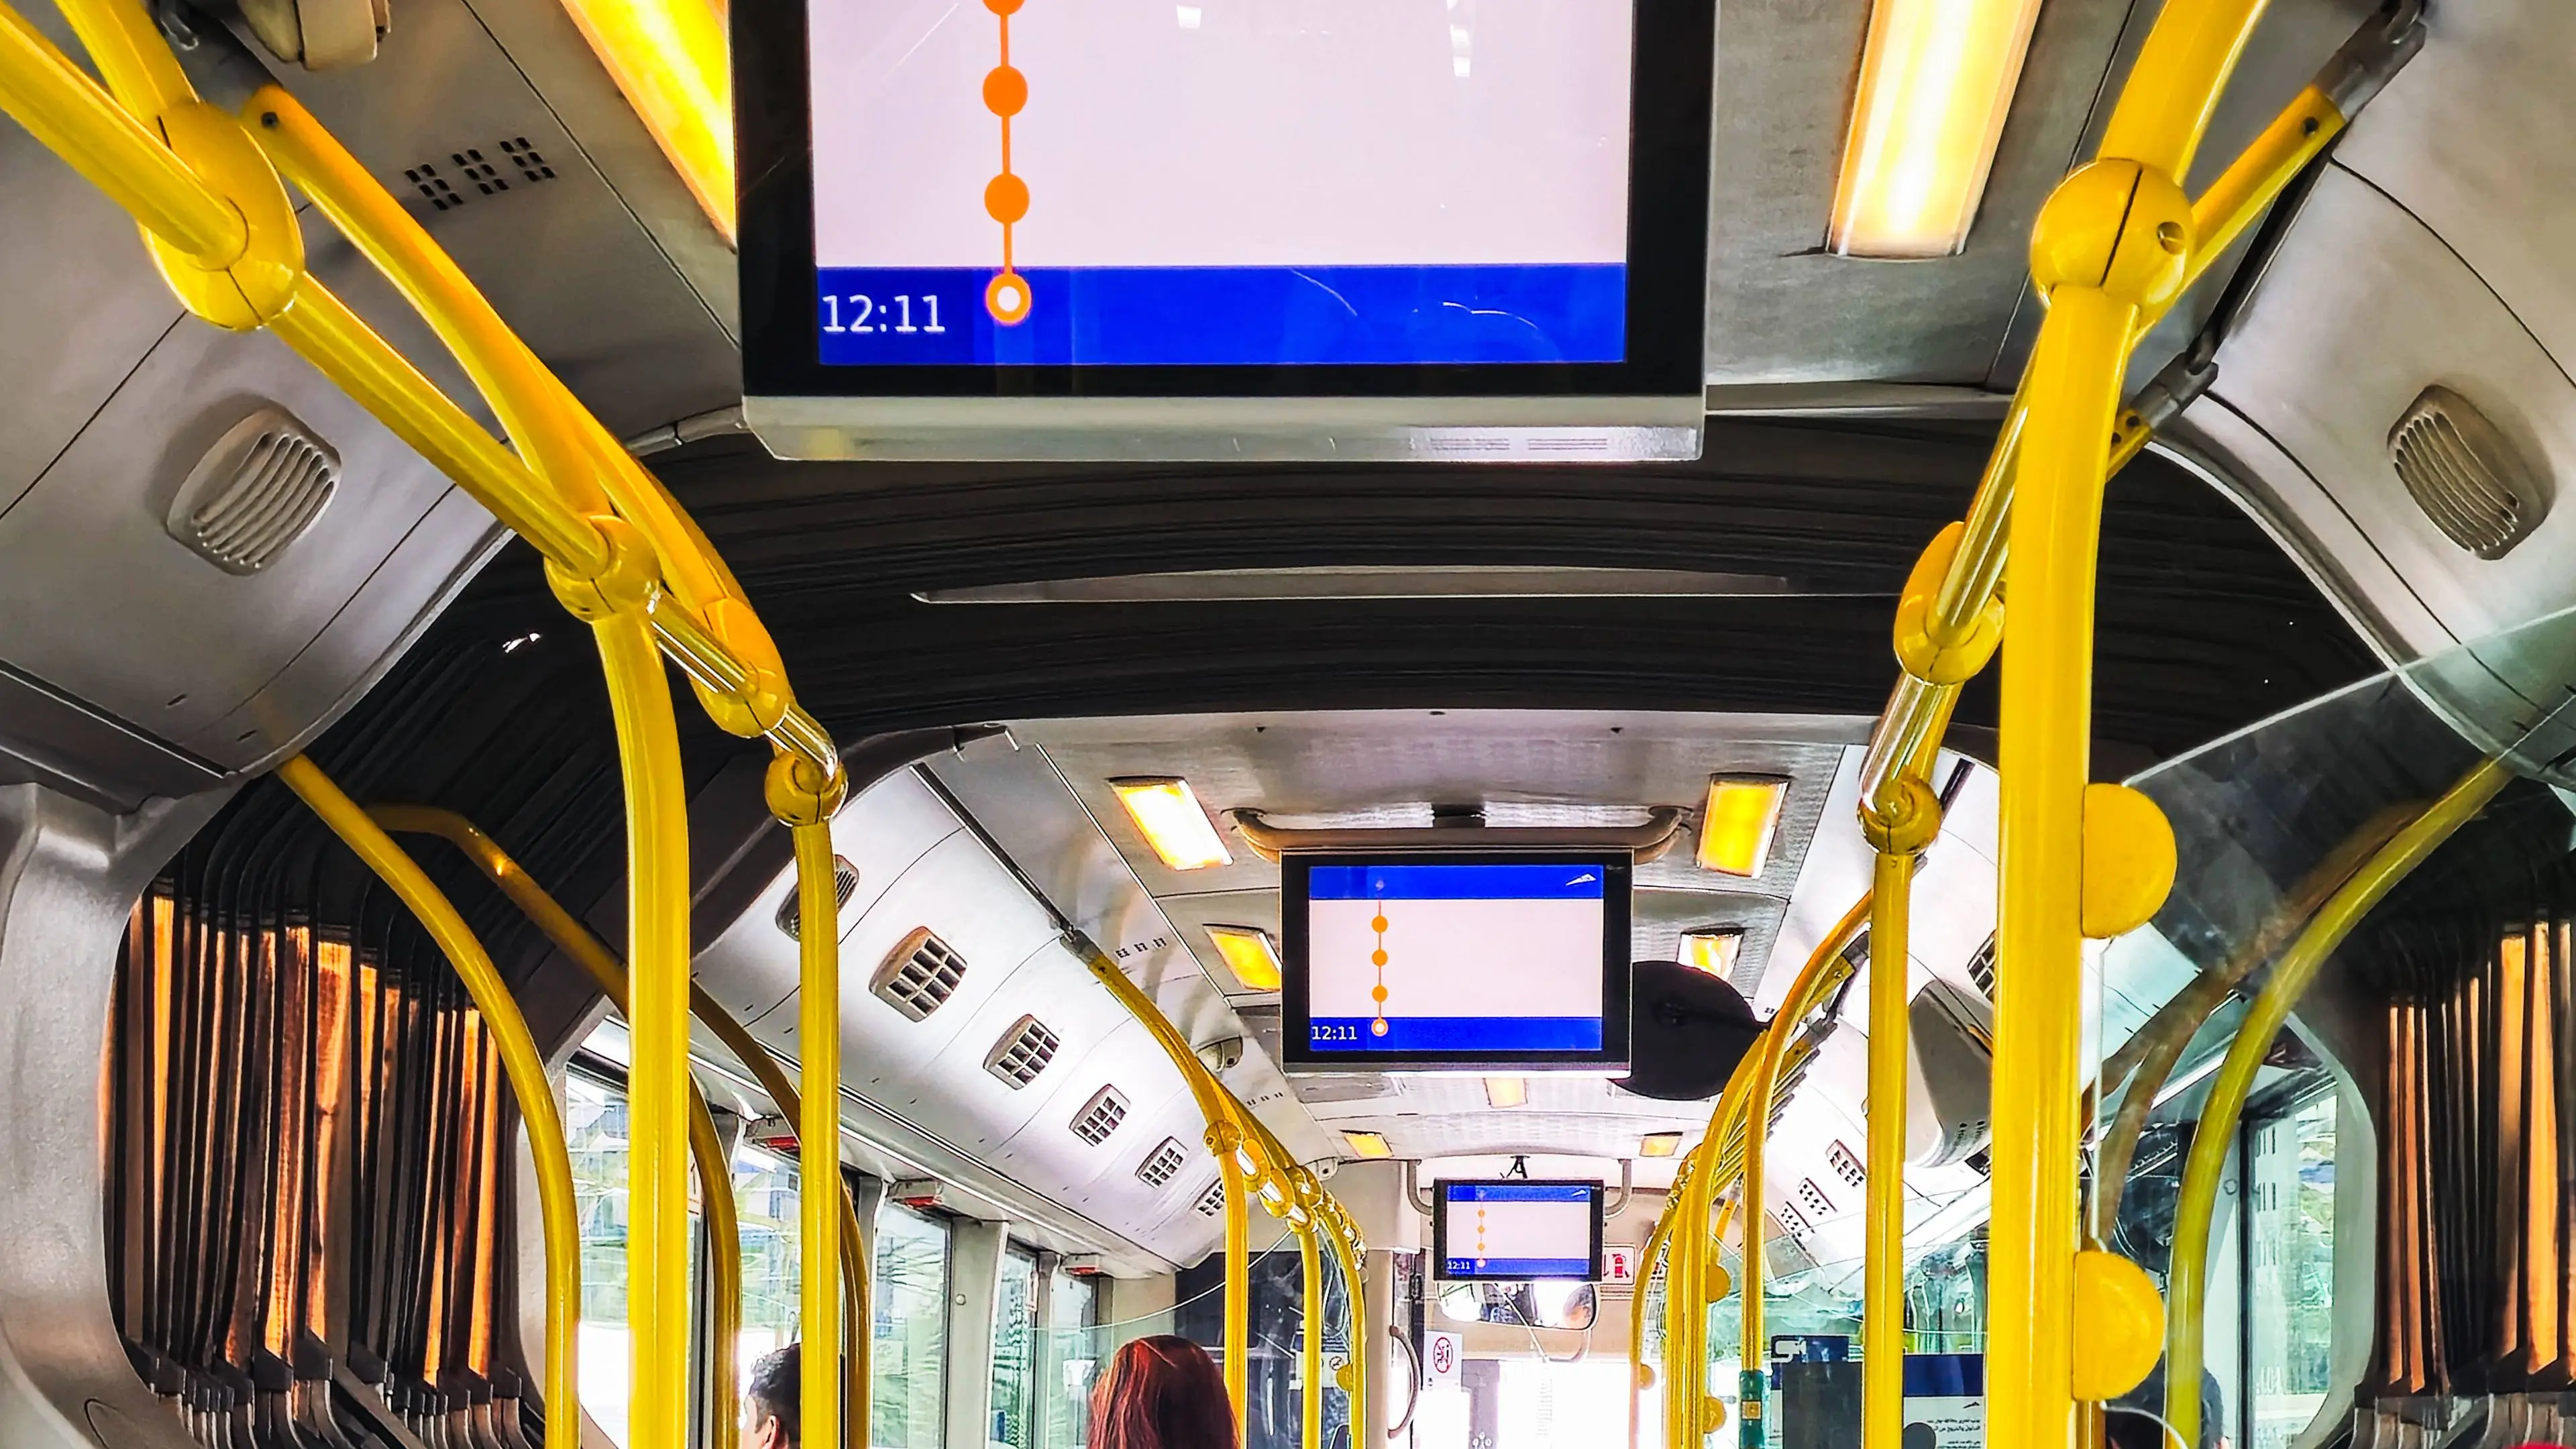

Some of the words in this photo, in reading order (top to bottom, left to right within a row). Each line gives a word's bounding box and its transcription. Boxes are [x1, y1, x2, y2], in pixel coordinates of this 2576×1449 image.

[822, 294, 946, 332] 12:11
[1311, 1026, 1358, 1040] 12:11
[1446, 1260, 1470, 1270] 12:11
